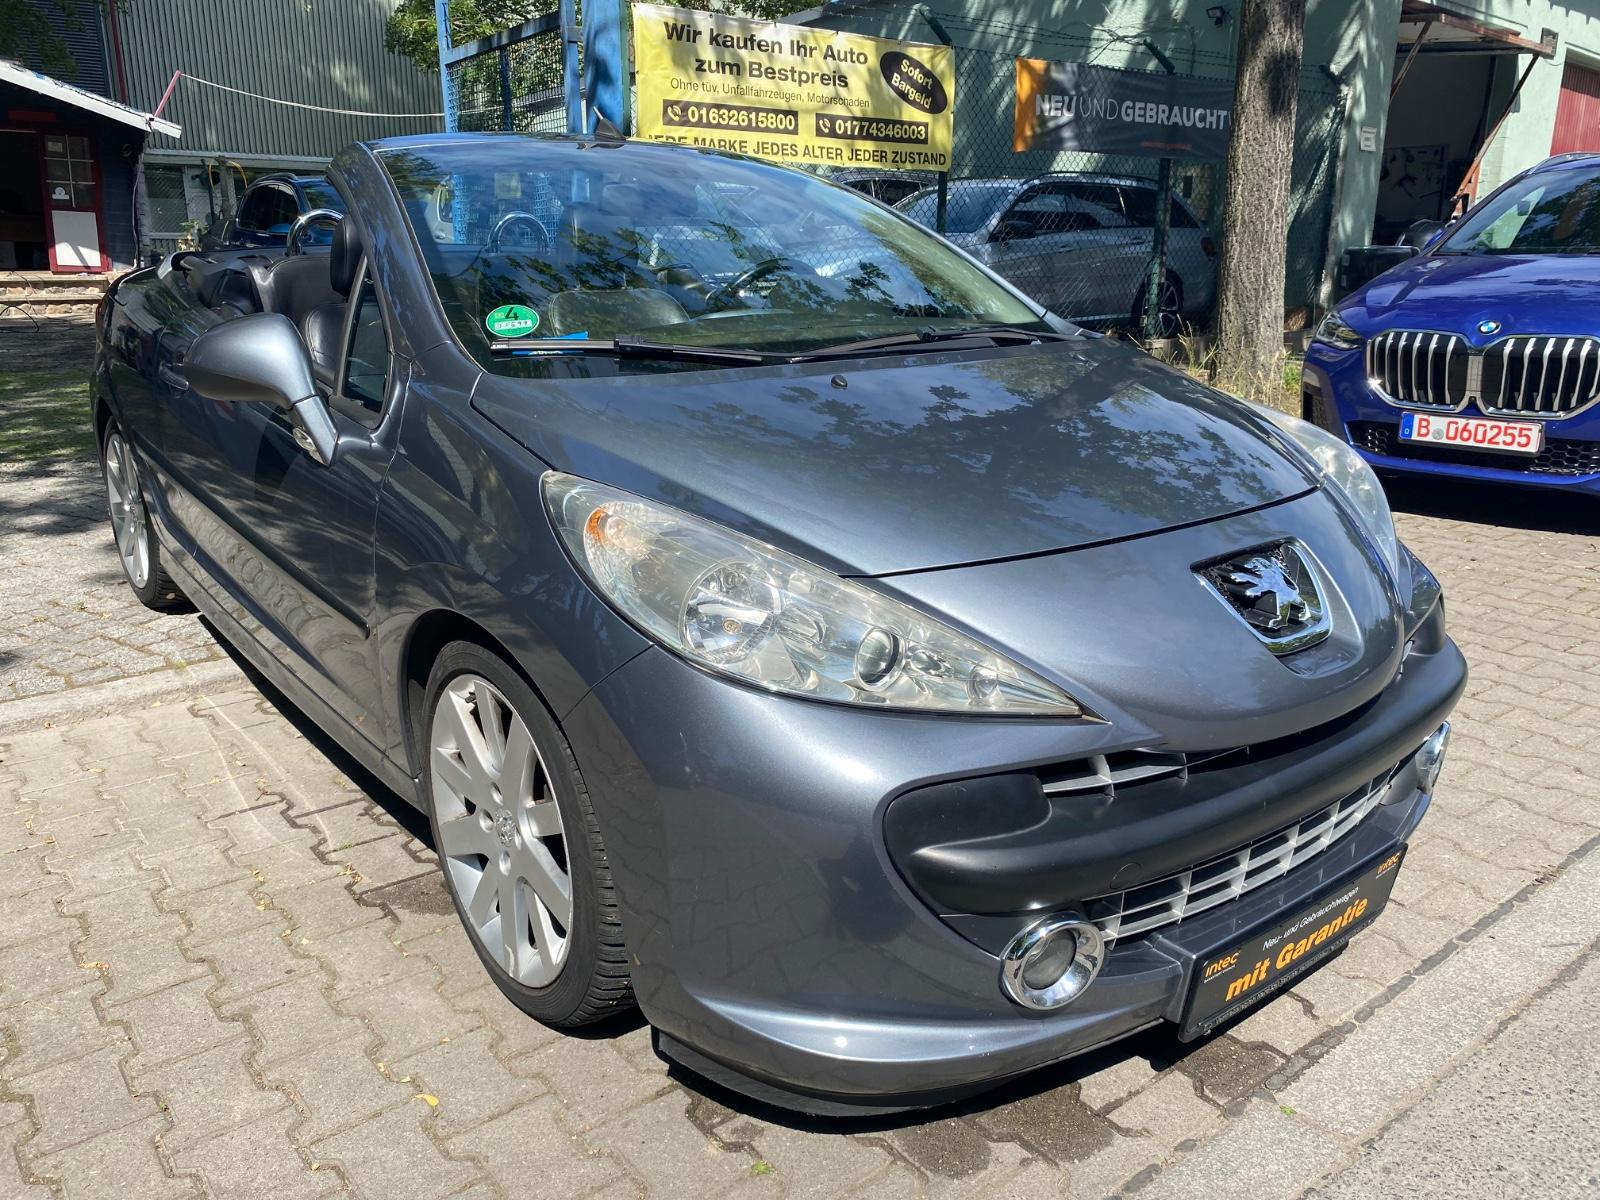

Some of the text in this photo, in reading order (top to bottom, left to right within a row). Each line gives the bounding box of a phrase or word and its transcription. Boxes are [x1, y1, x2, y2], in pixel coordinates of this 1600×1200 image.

[663, 22, 868, 65] Wir kaufen Ihr Auto
[695, 58, 849, 88] zum Bestpreis
[901, 59, 933, 90] Sofort
[670, 77, 699, 92] Ohne
[722, 83, 805, 103] Unfallfahrzeugen,
[807, 92, 870, 108] Motorschaden
[891, 72, 932, 109] Bargeld
[687, 105, 796, 130] 01632615800
[1035, 94, 1233, 130] NEU UND GEBRAUCHT
[835, 119, 926, 140] 01774346003
[753, 141, 799, 157] JEDES
[803, 144, 843, 161] ALTER
[848, 148, 888, 163] JEDER
[891, 150, 947, 166] ZUSTAND
[504, 306, 519, 320] 4
[1417, 417, 1533, 448] B 060255
[1262, 886, 1360, 951] Neu- und Gebrauchtwagen
[1204, 951, 1241, 978] intec
[1225, 957, 1271, 1002] mit
[1276, 897, 1368, 970] Garantie
